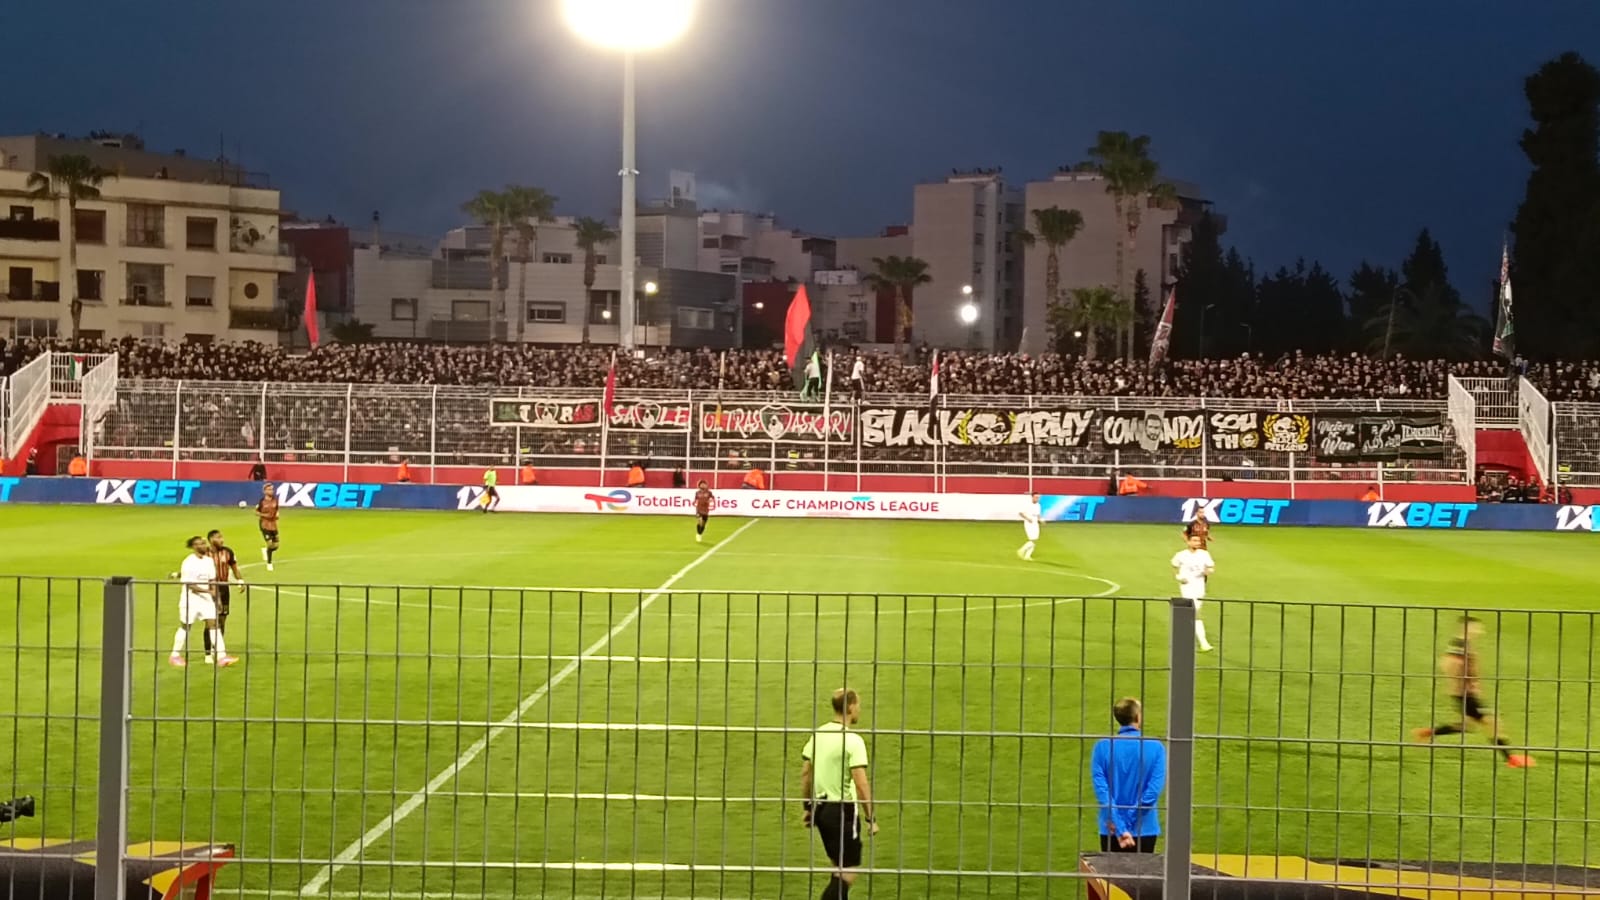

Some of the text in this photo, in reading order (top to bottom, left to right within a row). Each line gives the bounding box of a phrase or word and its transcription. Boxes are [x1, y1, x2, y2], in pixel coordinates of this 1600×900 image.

[860, 408, 965, 447] BLACK
[95, 479, 201, 504] 1XBET
[276, 482, 381, 508] 1XBET
[751, 499, 940, 512] CAF CHAMPIONS LEAGUE
[1181, 498, 1290, 524] 1XBET
[1367, 501, 1477, 528] 1XBET
